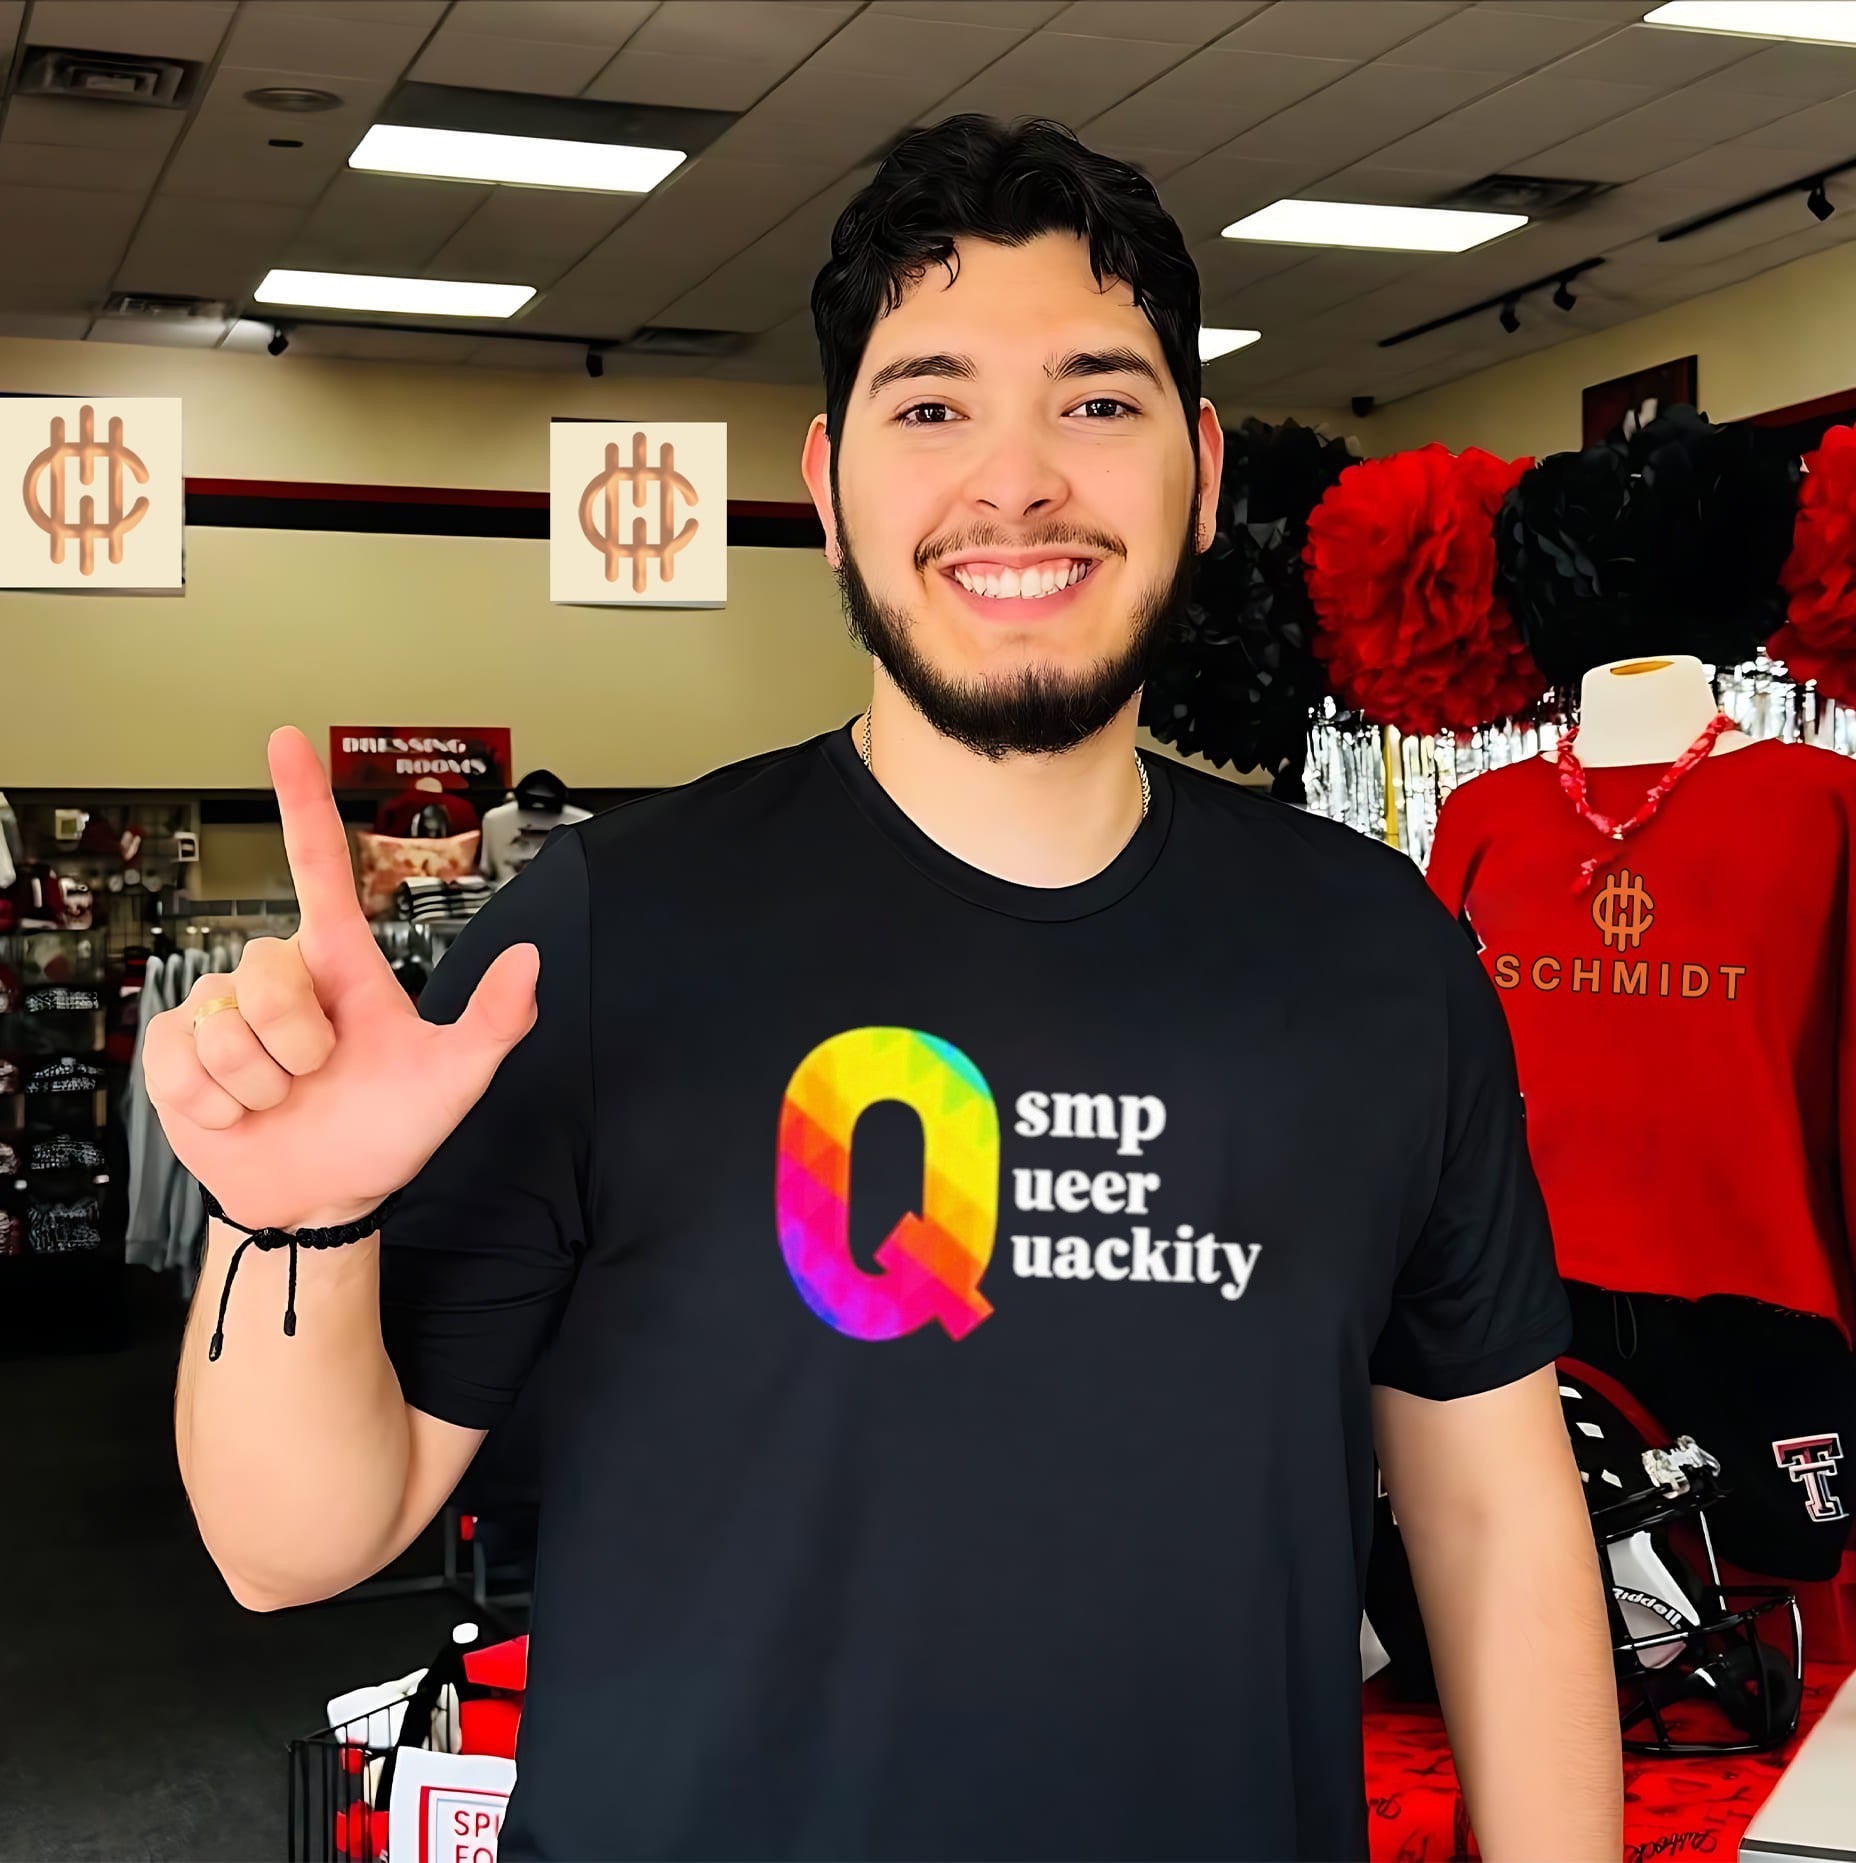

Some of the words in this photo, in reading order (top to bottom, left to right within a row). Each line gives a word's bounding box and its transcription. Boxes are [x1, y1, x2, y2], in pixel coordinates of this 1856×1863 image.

[396, 758, 487, 775] ROOMS
[1494, 954, 1746, 999] SCHMIDT
[1014, 1090, 1167, 1157] smp
[775, 1026, 1000, 1342] Q
[1012, 1167, 1161, 1215] ueer
[1010, 1224, 1263, 1301] uackity
